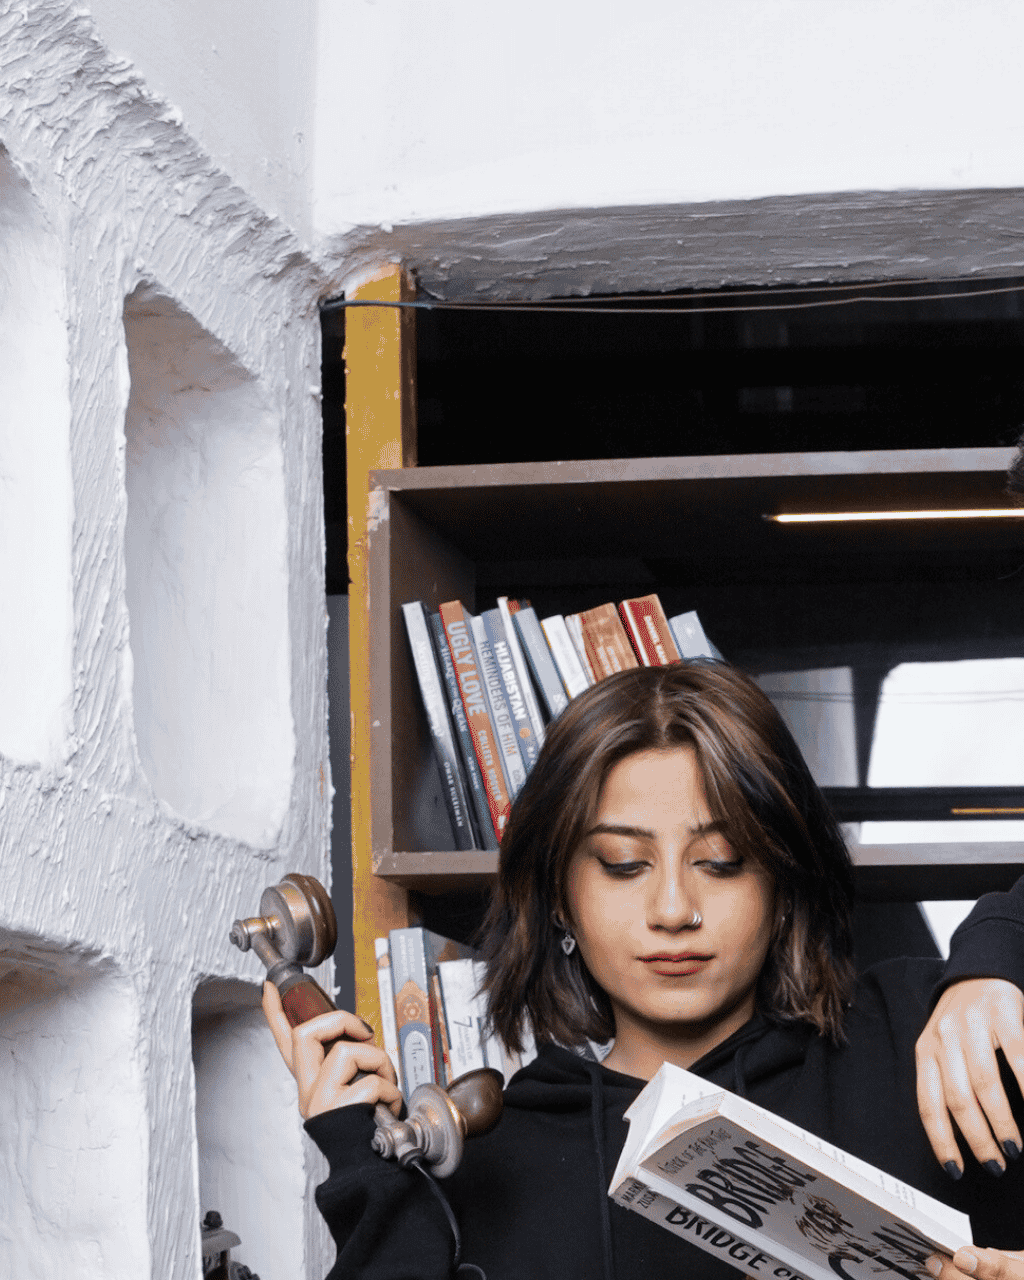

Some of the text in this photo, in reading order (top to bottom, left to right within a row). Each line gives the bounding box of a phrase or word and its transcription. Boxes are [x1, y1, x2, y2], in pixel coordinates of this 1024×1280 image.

[447, 620, 487, 717] UGLY LOVE
[479, 640, 518, 757] REMINDERS OF HIM
[493, 640, 527, 721] HIJABISTAN
[478, 729, 503, 801] COLLEEN HOOVER
[637, 1190, 657, 1209] ZUSA
[684, 1140, 817, 1228] BRIDGE
[665, 1206, 770, 1271] BRIDGE
